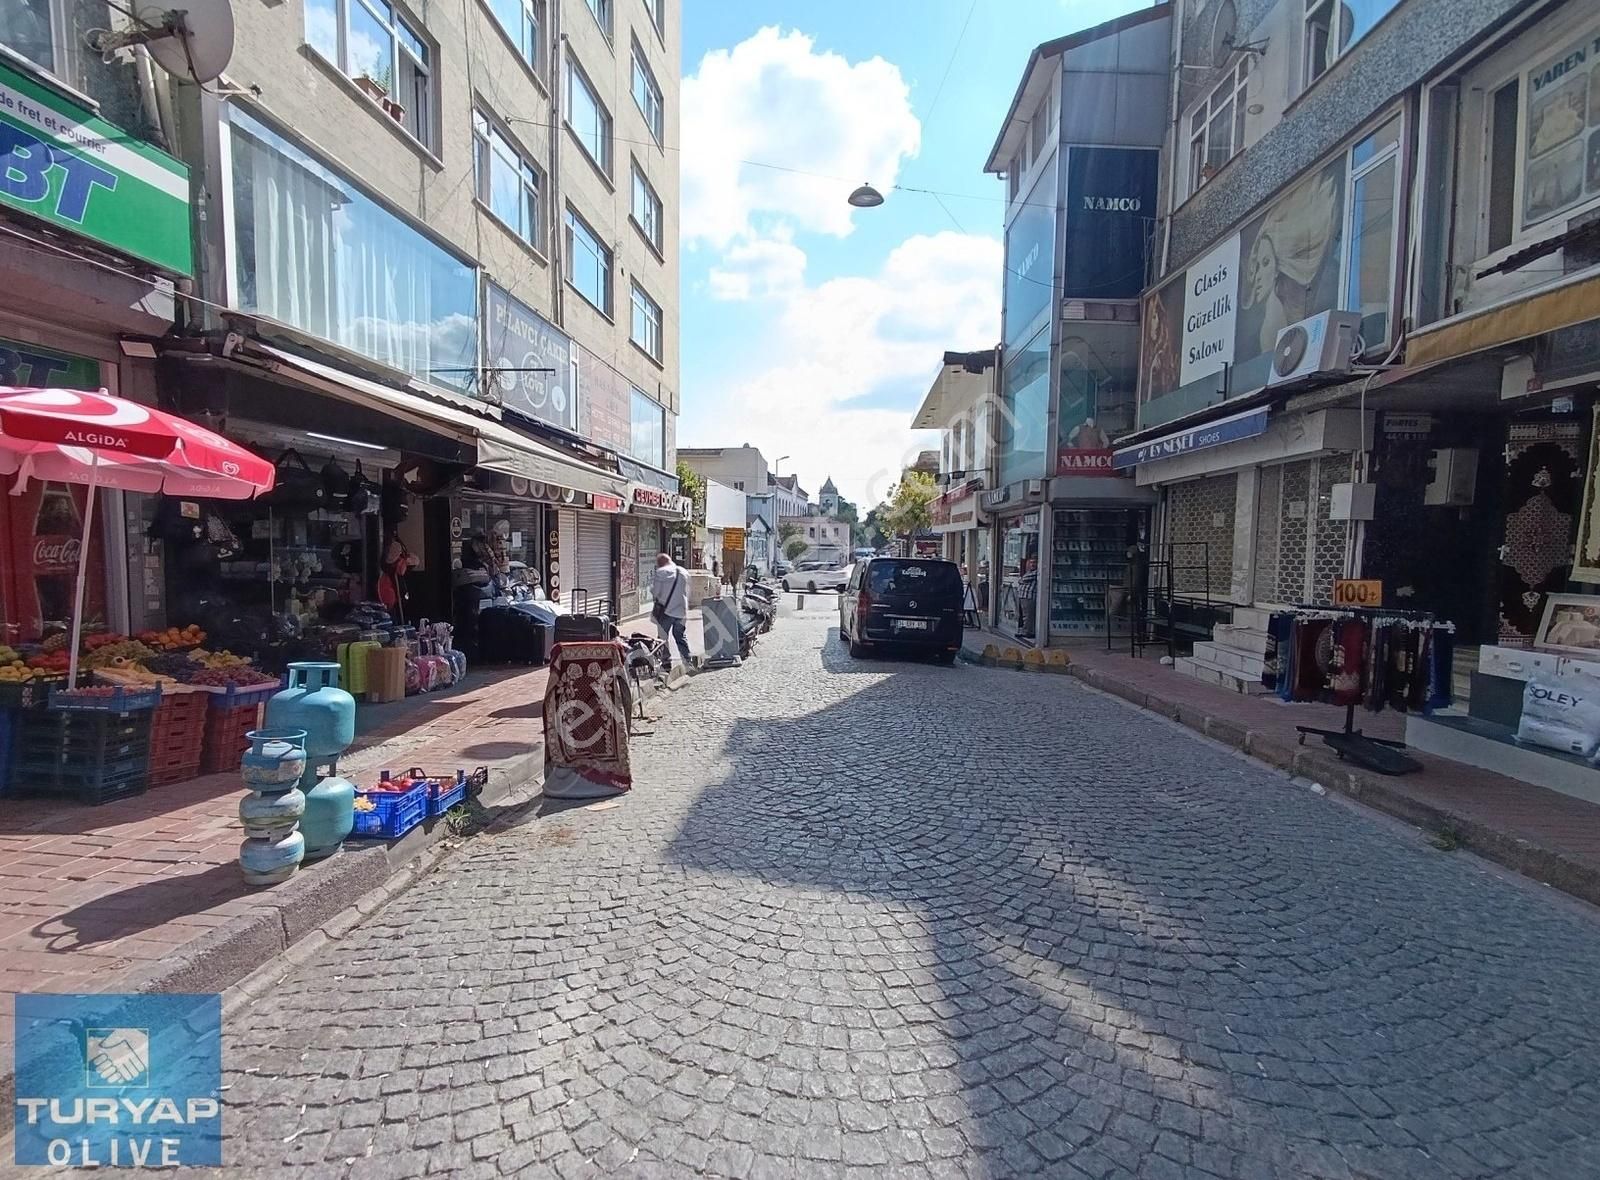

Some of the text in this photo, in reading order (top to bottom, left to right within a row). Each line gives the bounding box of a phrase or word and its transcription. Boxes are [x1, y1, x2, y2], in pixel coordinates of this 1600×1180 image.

[1533, 46, 1587, 92] YAREN
[18, 100, 42, 123] fret
[44, 116, 58, 131] et
[59, 124, 106, 154] courrier
[1083, 196, 1141, 211] NAMCO
[1187, 294, 1231, 333] Güzellik
[1199, 432, 1220, 447] SHOES
[1528, 685, 1583, 708] SOLEY
